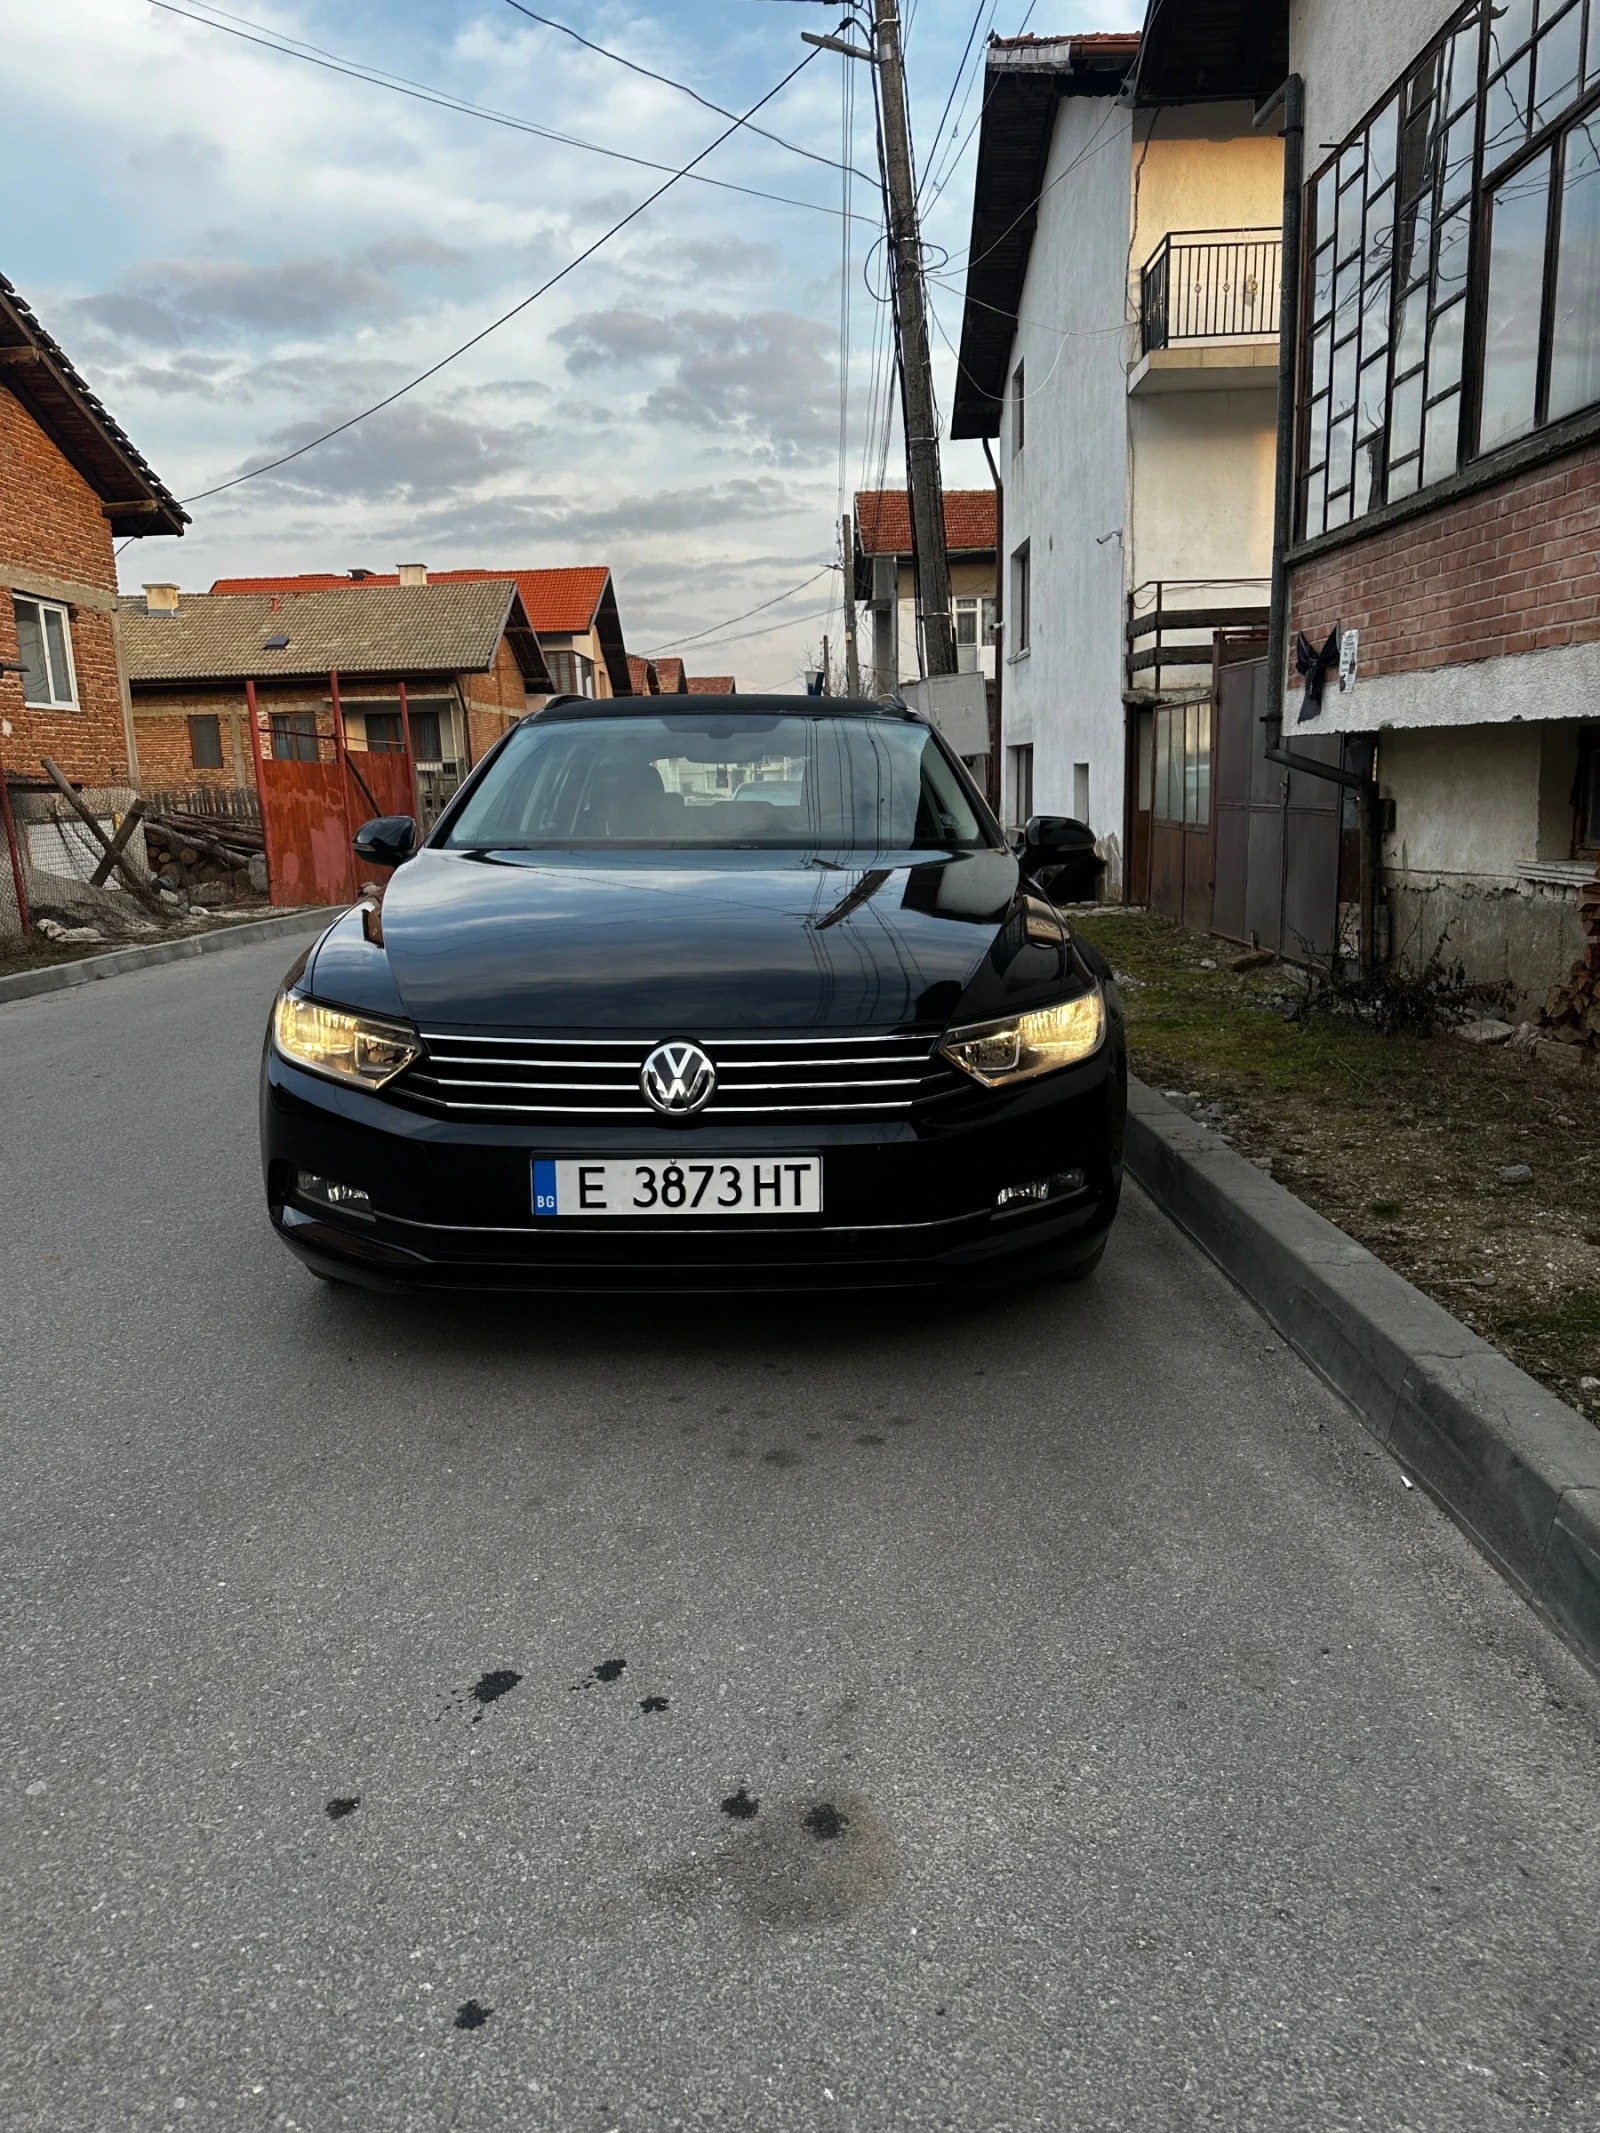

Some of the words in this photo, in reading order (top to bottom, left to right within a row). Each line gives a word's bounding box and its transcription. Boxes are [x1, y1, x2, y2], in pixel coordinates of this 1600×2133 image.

[642, 1041, 716, 1113] VW
[537, 1195, 555, 1208] BG
[578, 1166, 607, 1209] E
